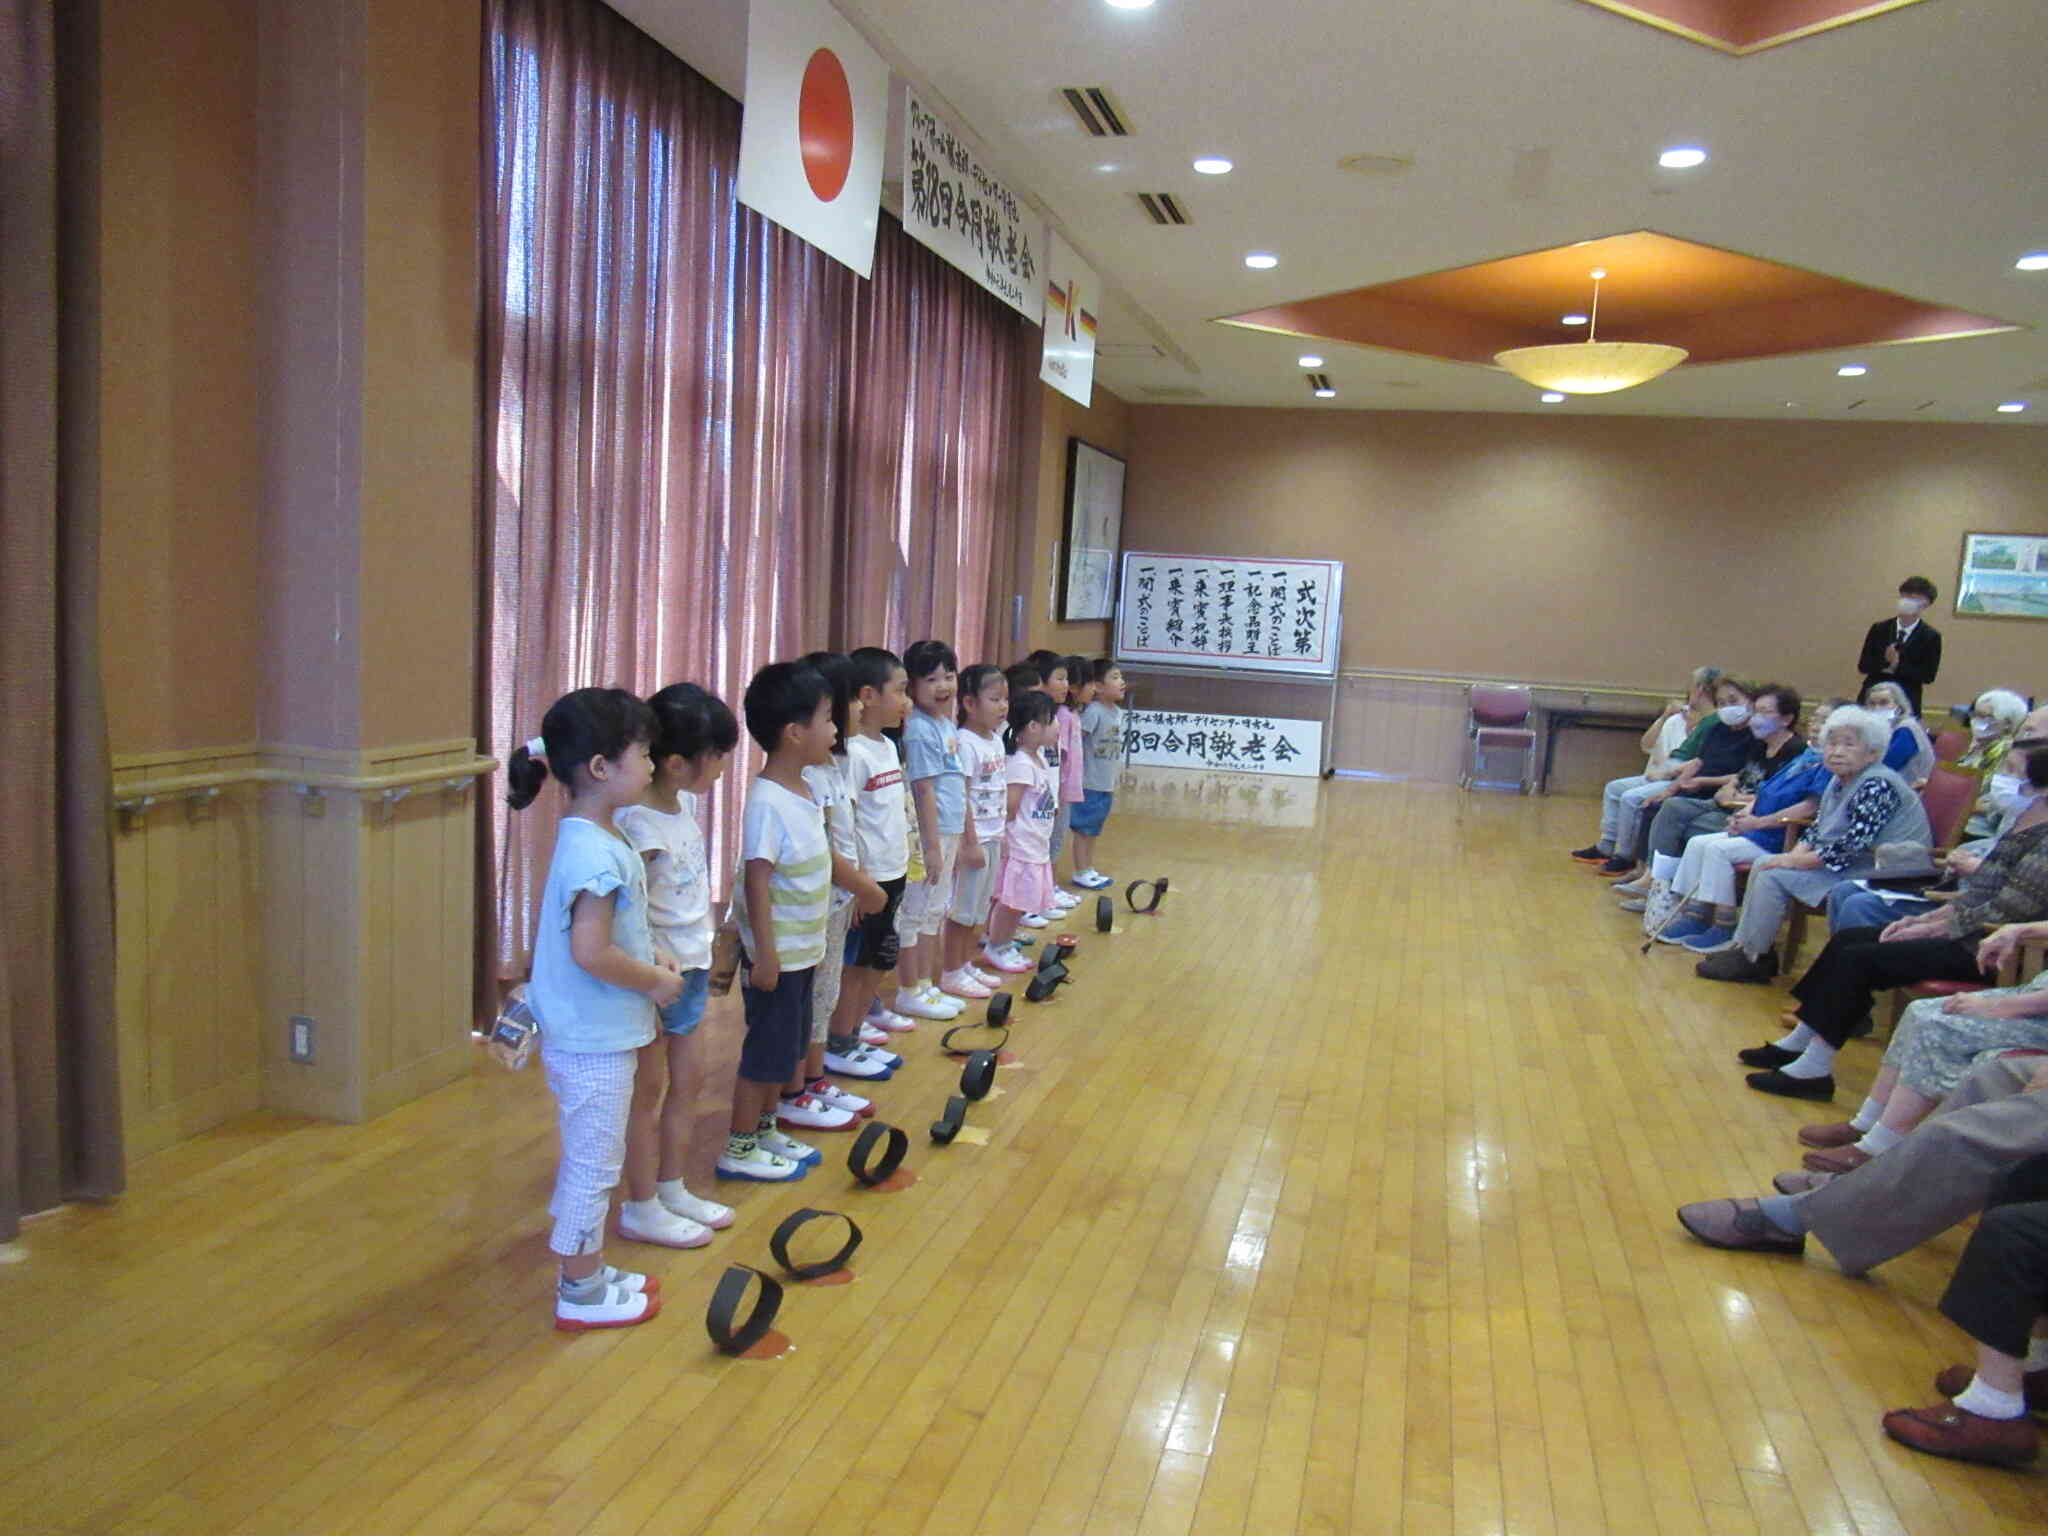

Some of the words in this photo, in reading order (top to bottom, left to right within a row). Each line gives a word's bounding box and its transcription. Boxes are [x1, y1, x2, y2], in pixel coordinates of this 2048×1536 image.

[911, 137, 1035, 283] 第18回合同敬老会
[1293, 579, 1316, 655] 式次第
